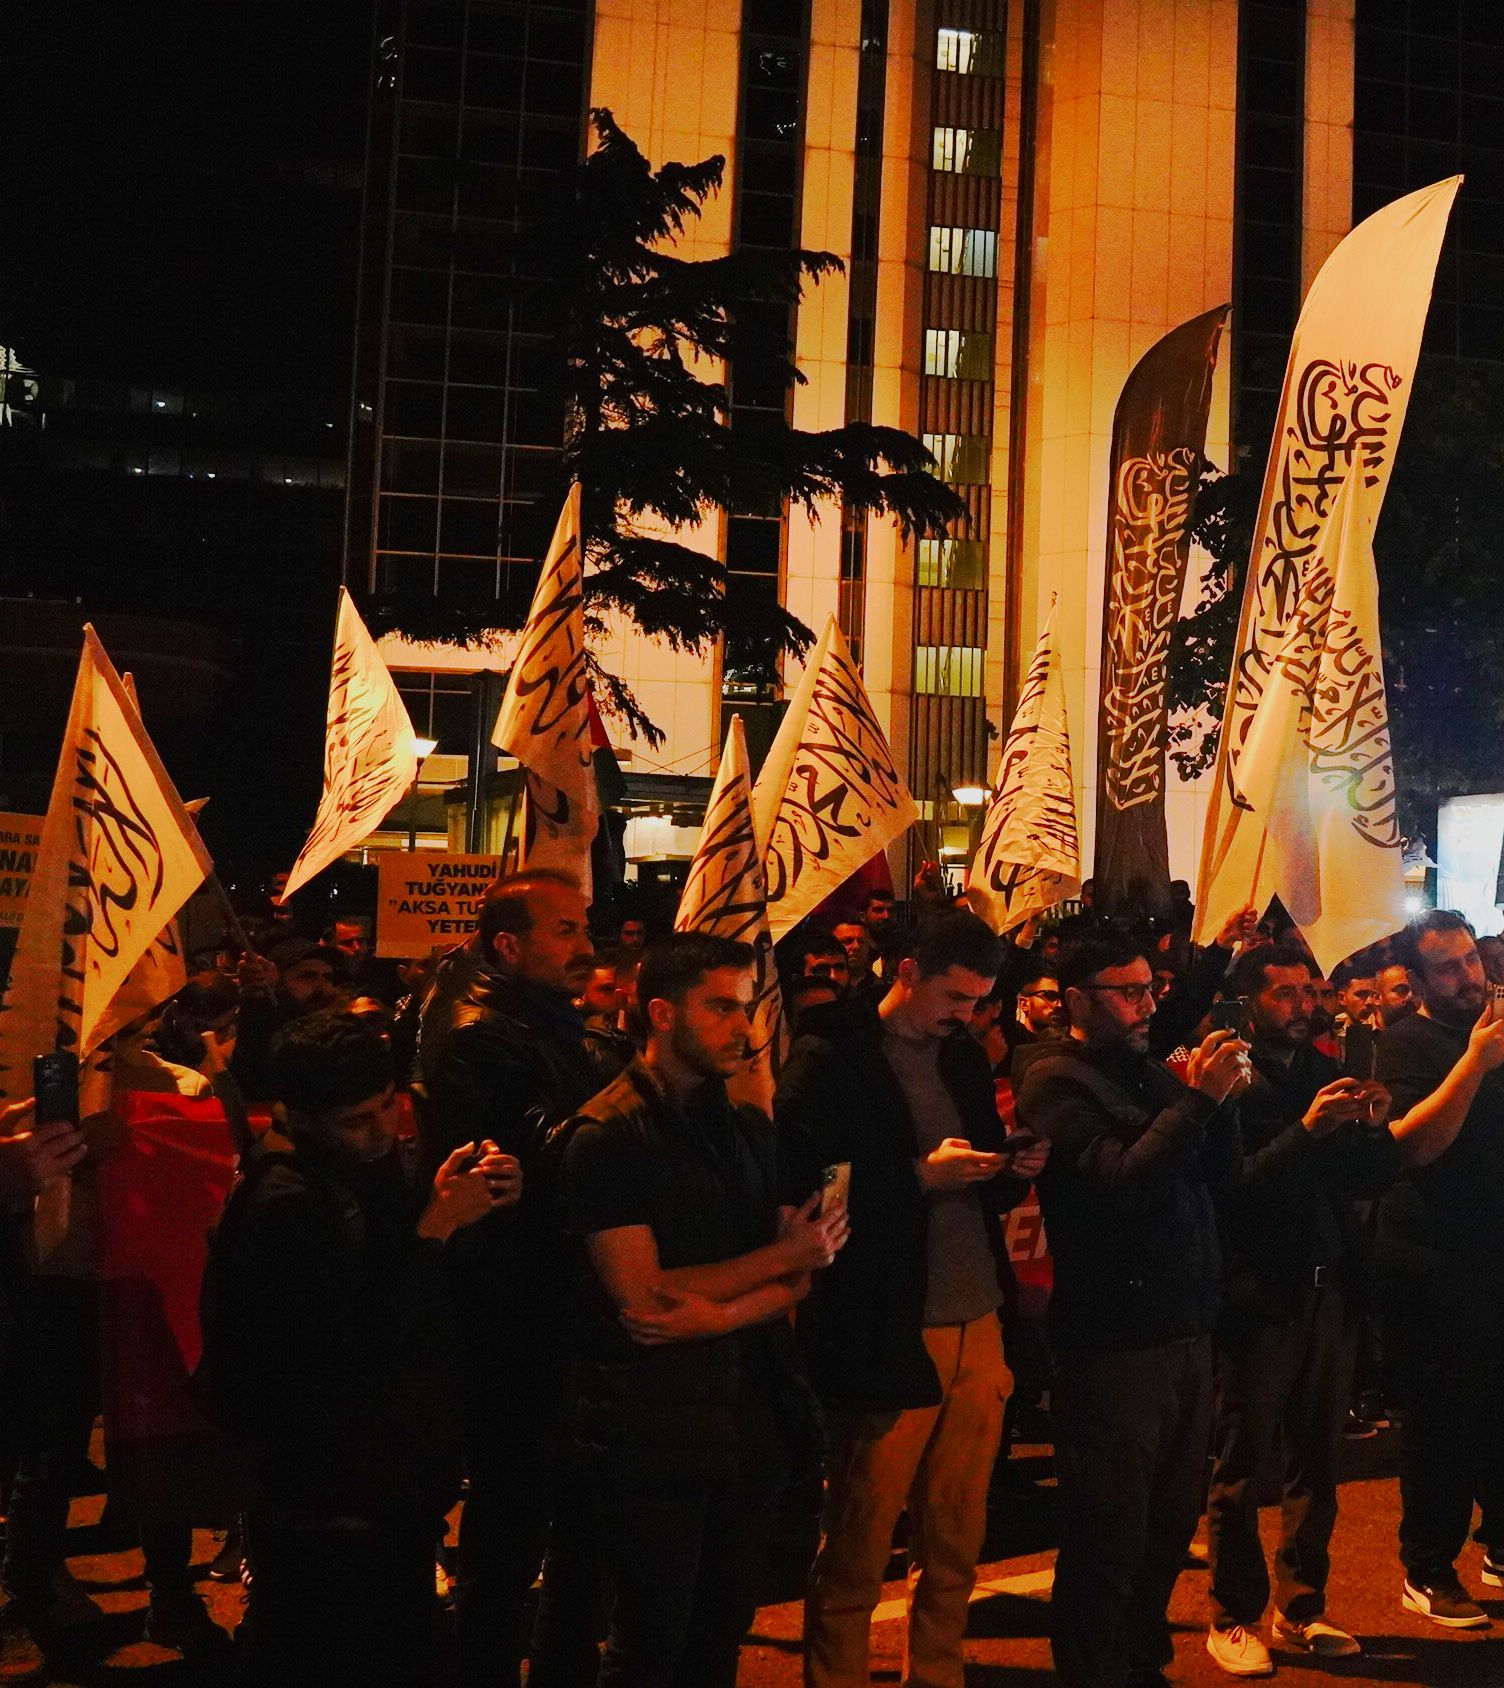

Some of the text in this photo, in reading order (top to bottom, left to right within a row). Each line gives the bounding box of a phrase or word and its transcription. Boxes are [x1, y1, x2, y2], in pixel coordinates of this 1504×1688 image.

[428, 862, 497, 879] YAHUDİ
[455, 902, 479, 915] TU
[427, 919, 480, 934] YETE
